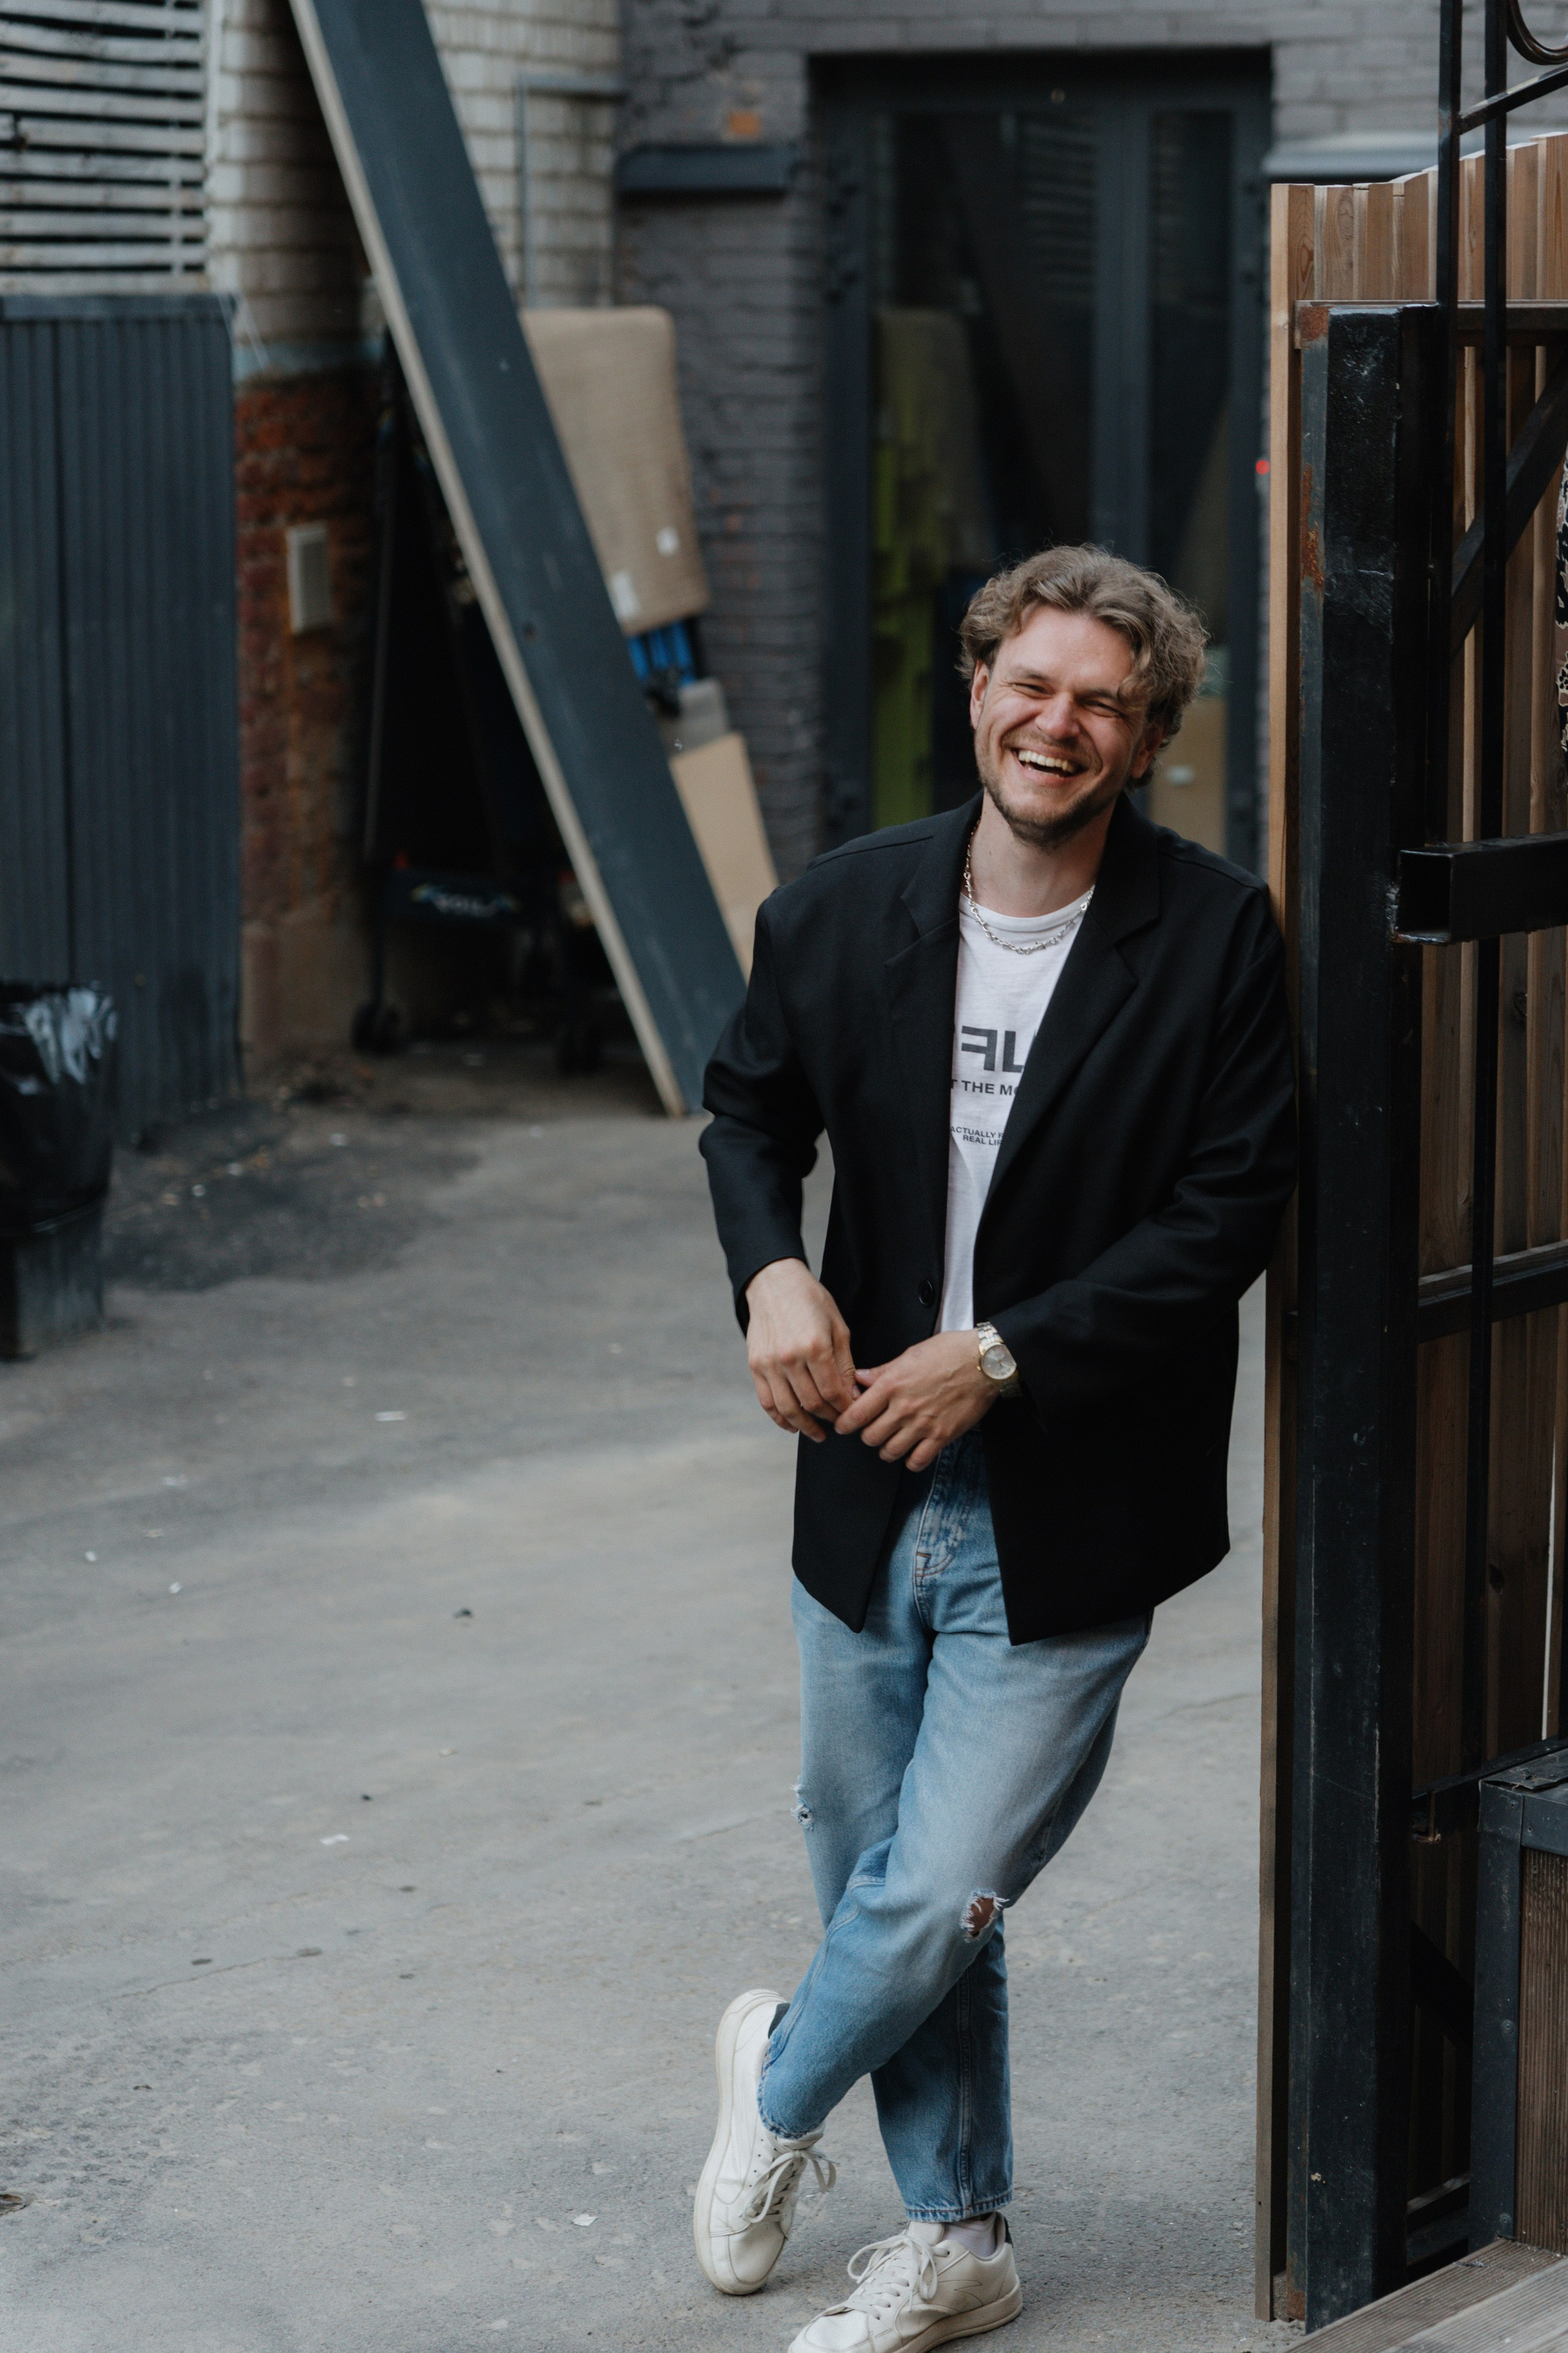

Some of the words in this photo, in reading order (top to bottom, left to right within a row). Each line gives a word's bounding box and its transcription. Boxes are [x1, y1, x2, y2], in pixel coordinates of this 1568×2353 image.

[961, 1080, 995, 1094] THE
[951, 1126, 996, 1138] ACTUALLY
[963, 1135, 986, 1144] REAL
